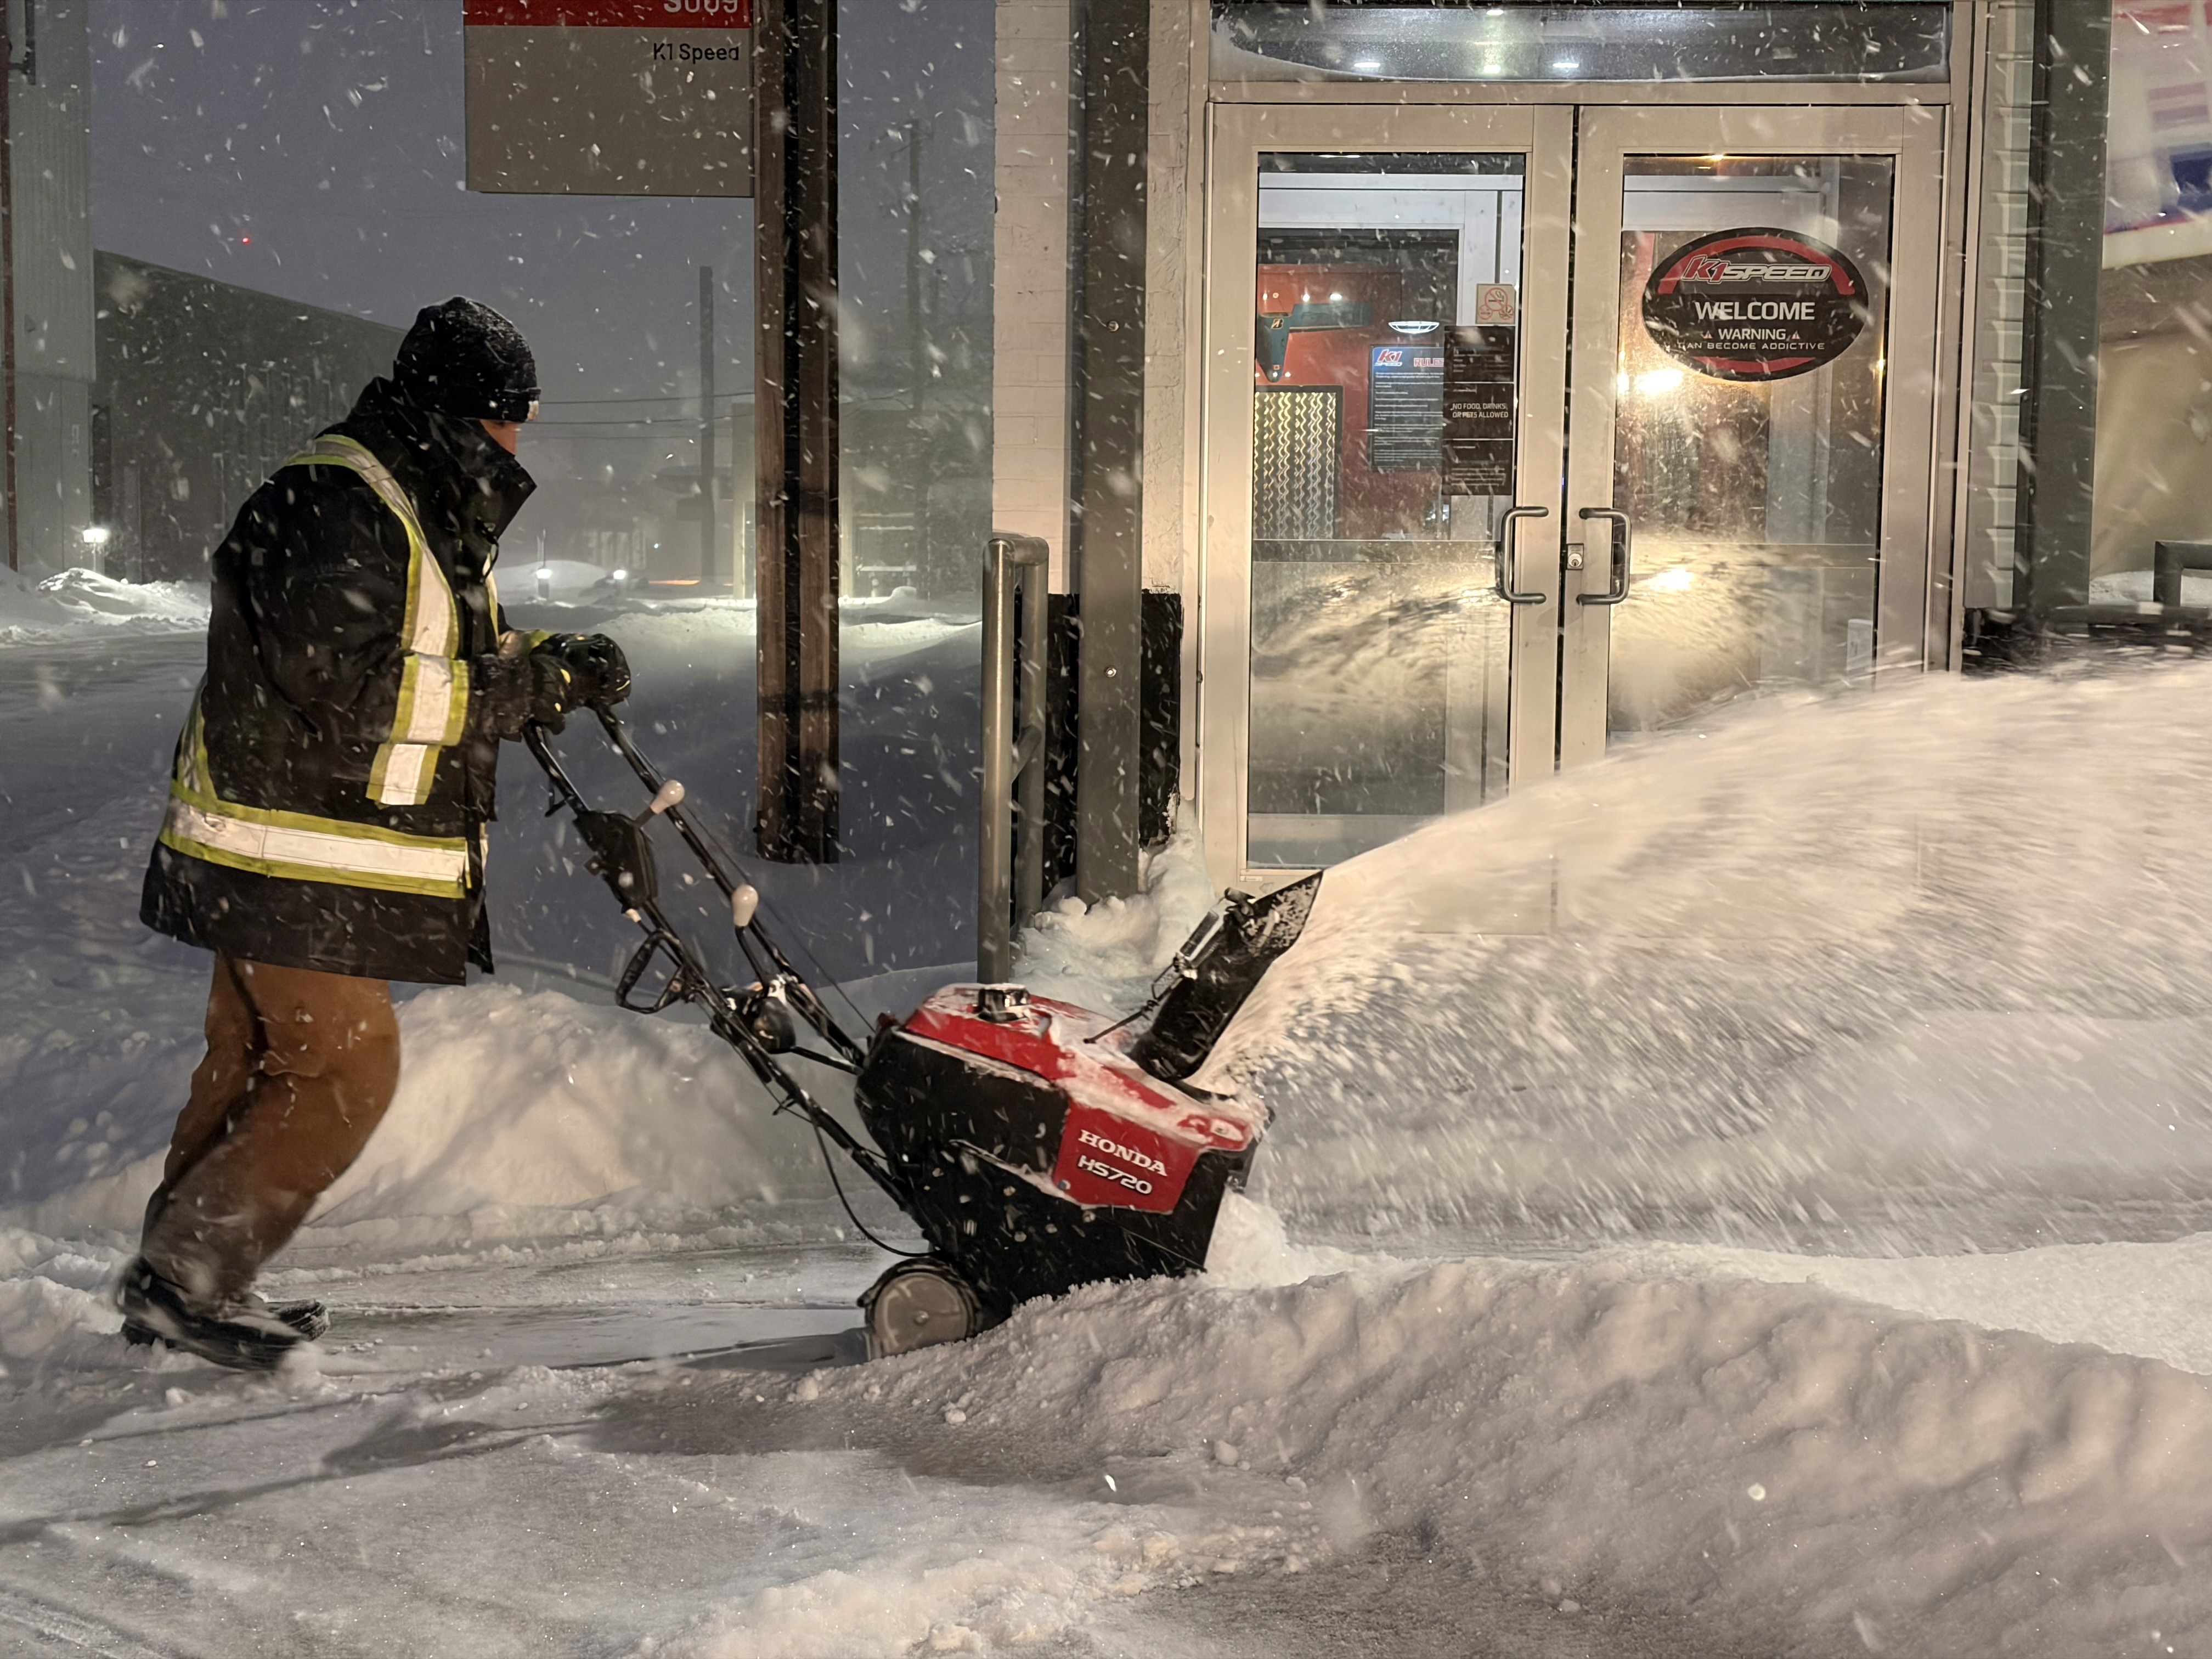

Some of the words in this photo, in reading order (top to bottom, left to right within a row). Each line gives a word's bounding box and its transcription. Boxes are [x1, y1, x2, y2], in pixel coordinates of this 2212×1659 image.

[653, 43, 673, 60] K1
[679, 43, 739, 64] Speed
[1695, 302, 1815, 320] WELCOME
[1718, 329, 1786, 340] WARNING
[1377, 349, 1403, 363] K1
[1413, 358, 1444, 367] RULES
[1078, 1129, 1168, 1177] HONDA
[1077, 1155, 1153, 1195] HS720
